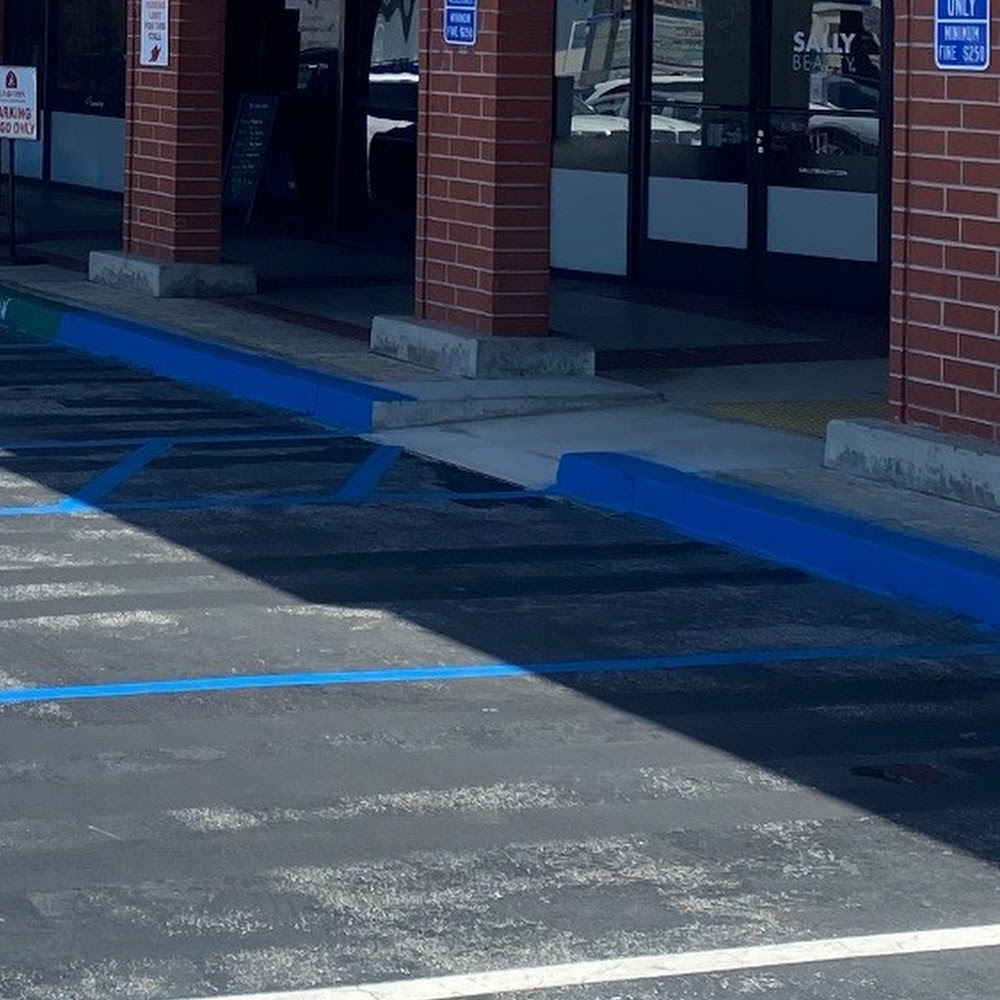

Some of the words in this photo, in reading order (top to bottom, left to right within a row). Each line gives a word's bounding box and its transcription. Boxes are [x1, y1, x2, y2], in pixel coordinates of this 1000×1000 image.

[793, 31, 857, 54] SALLY
[944, 26, 980, 42] MINIMUM
[792, 53, 857, 73] BEAY
[939, 45, 957, 61] FINE
[962, 46, 985, 63] $250
[13, 122, 35, 135] ONLY
